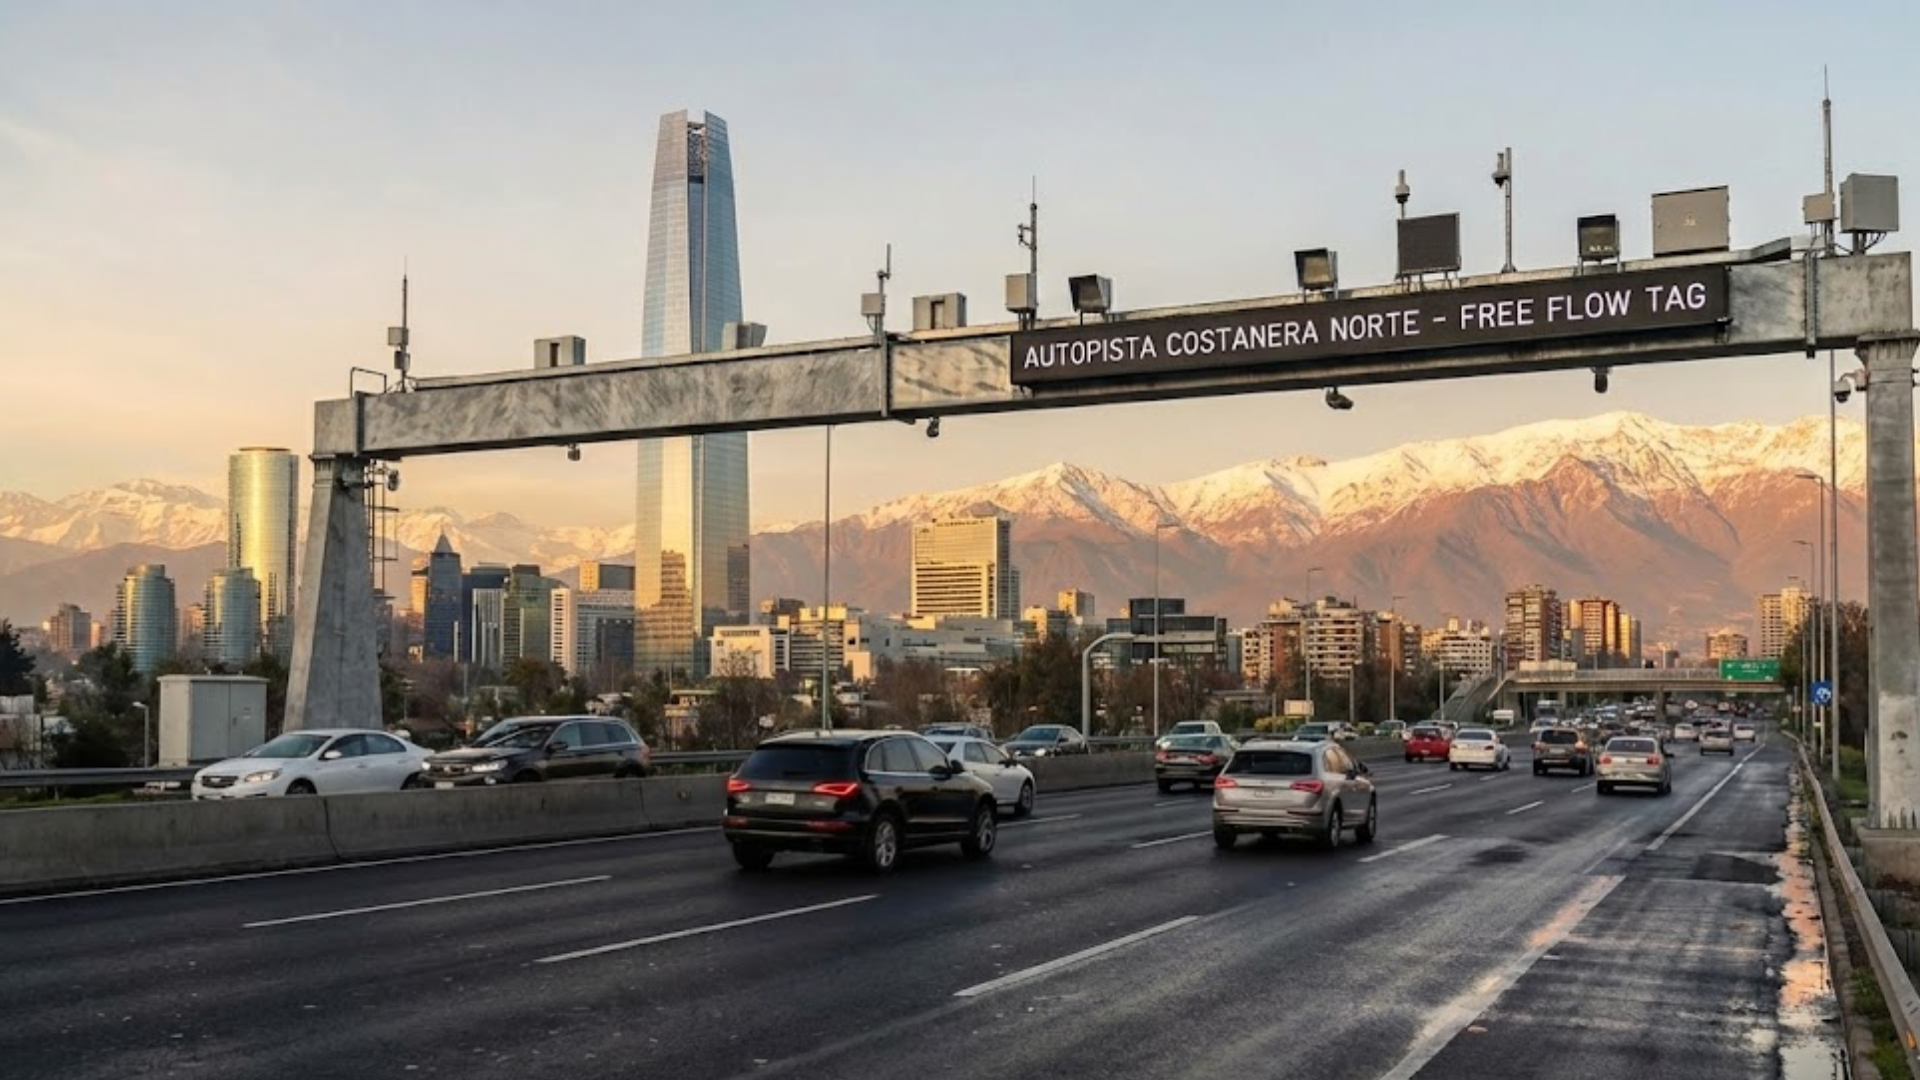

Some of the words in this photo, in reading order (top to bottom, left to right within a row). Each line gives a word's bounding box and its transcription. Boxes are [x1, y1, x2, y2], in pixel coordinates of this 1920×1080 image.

[1024, 335, 1157, 369] AUTOPISTA
[1166, 320, 1319, 356] COSTANERA
[1330, 309, 1420, 342] NORTE
[1461, 299, 1534, 330] FREE
[1547, 289, 1631, 322] FLOW
[1645, 282, 1706, 312] TAG
